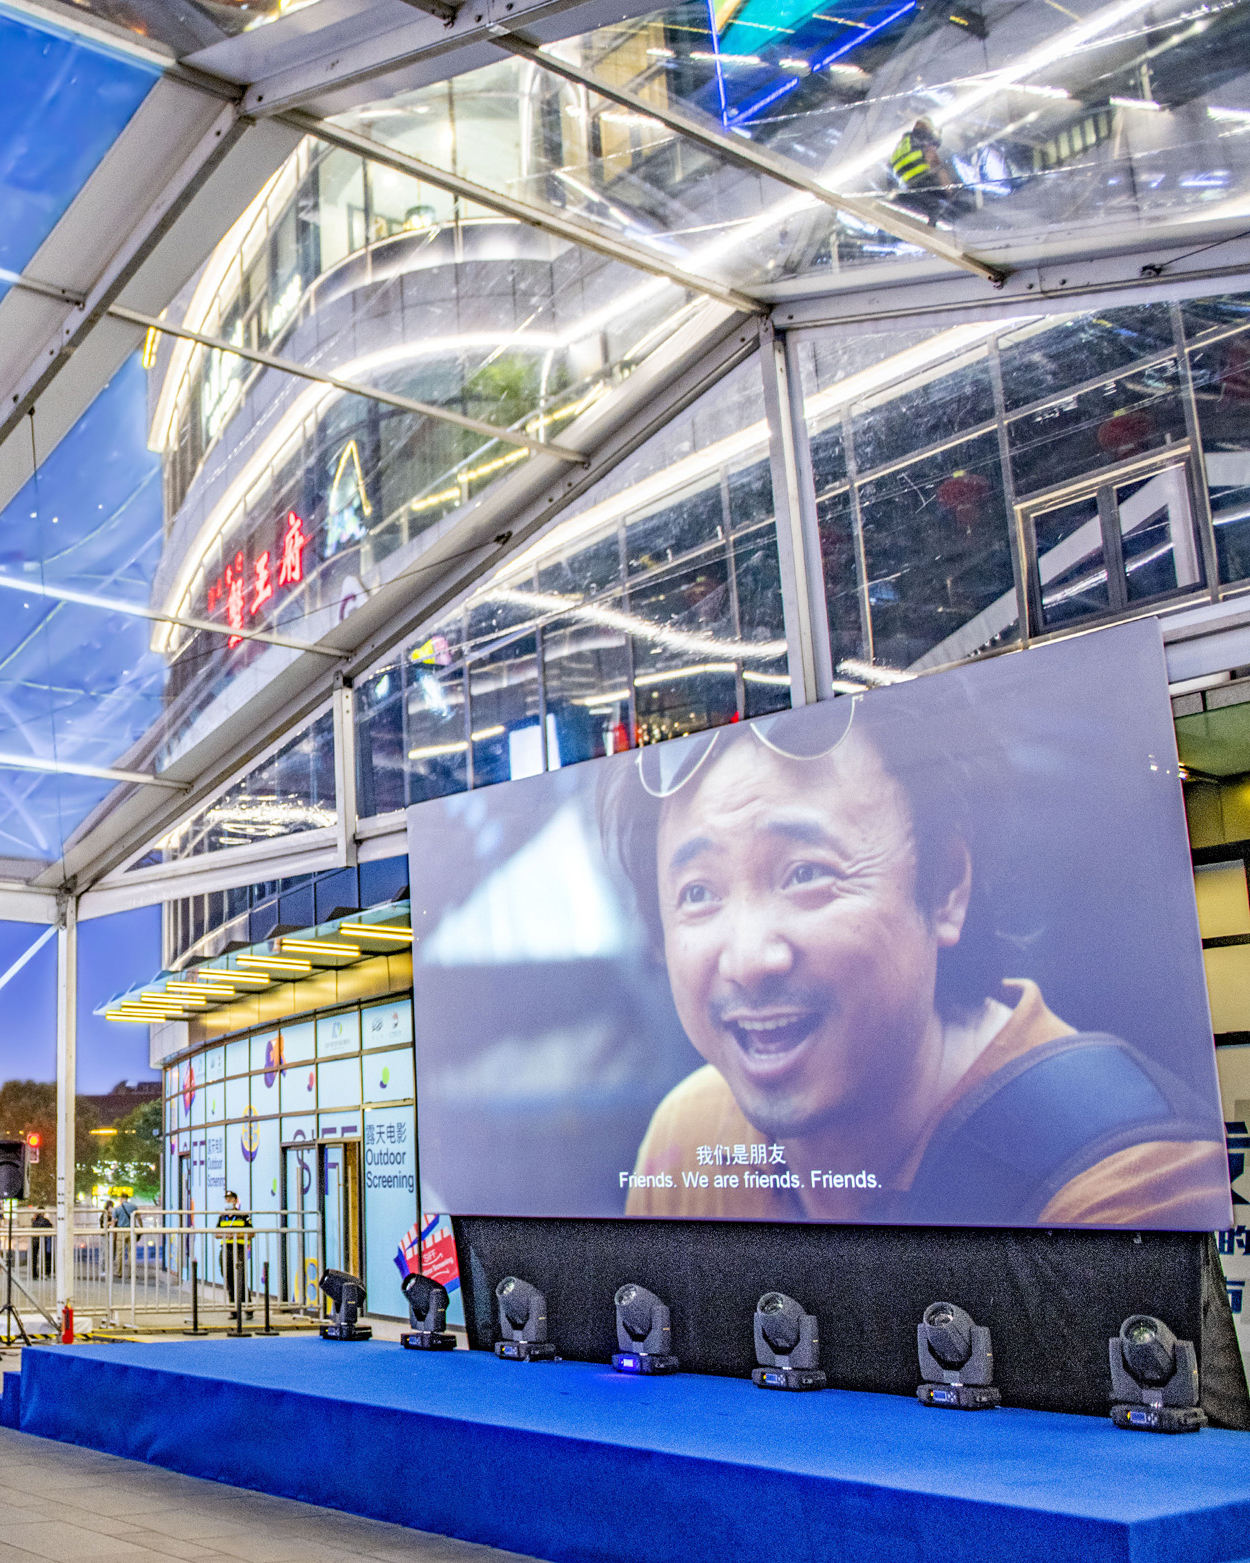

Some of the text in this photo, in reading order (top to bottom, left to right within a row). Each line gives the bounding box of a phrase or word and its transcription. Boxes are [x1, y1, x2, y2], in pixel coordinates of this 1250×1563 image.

[366, 1122, 406, 1145] 露天电影
[366, 1148, 406, 1166] Outdoor
[696, 1143, 787, 1165] 我们是朋友
[366, 1170, 415, 1193] Screening
[619, 1169, 883, 1189] Friends. We are friends. Friends.
